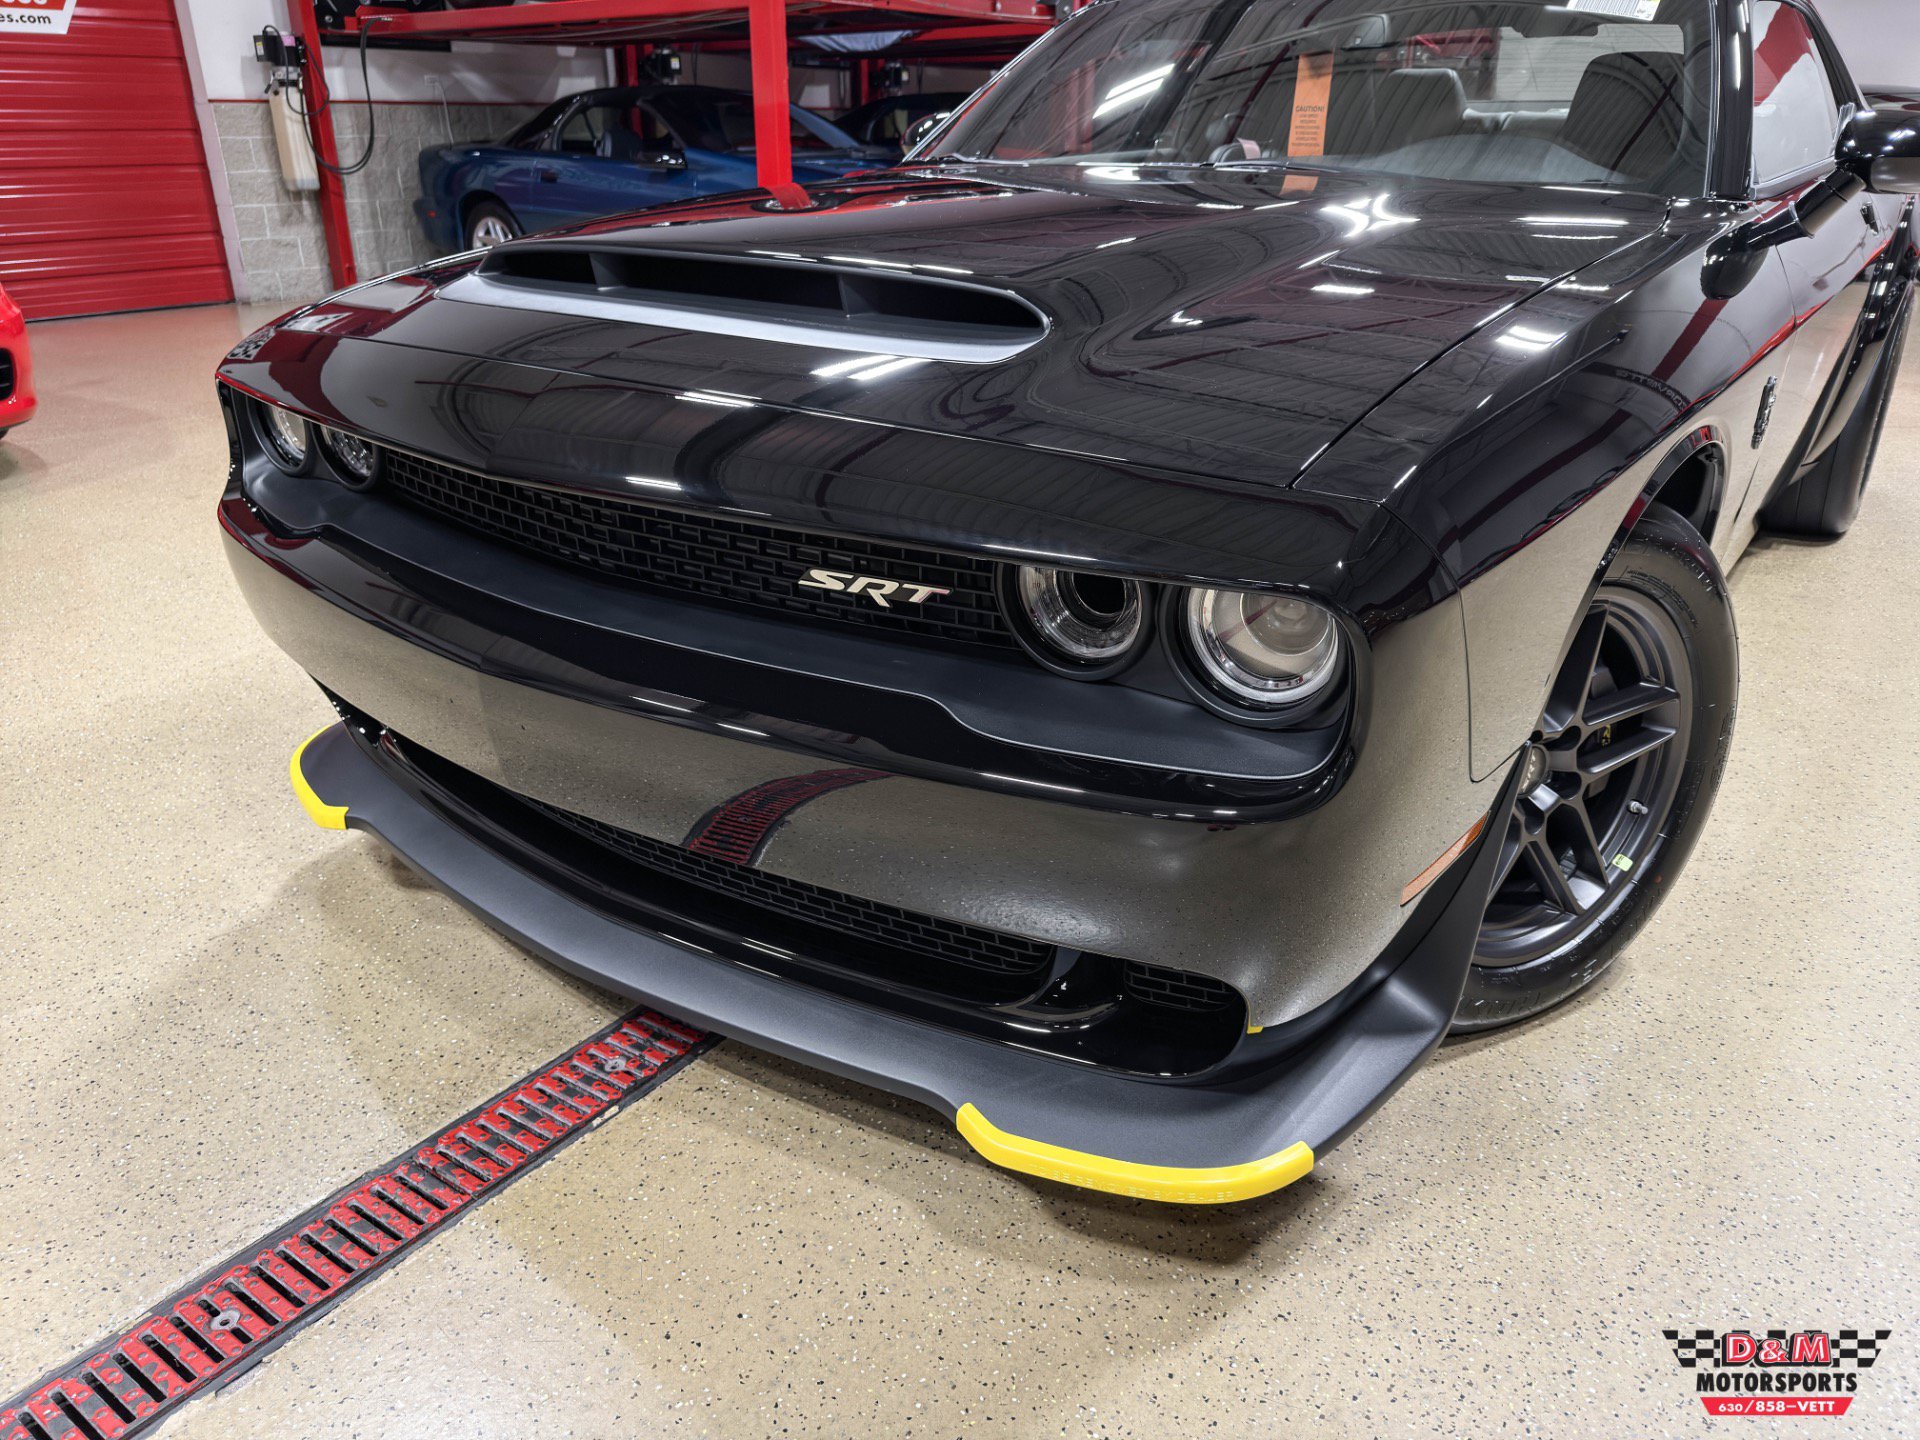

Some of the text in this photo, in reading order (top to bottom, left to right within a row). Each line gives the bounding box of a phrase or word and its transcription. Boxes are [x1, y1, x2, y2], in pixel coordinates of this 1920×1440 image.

[1296, 104, 1325, 113] CAUTION!
[797, 569, 951, 608] SRT
[1053, 1169, 1070, 1183] BE
